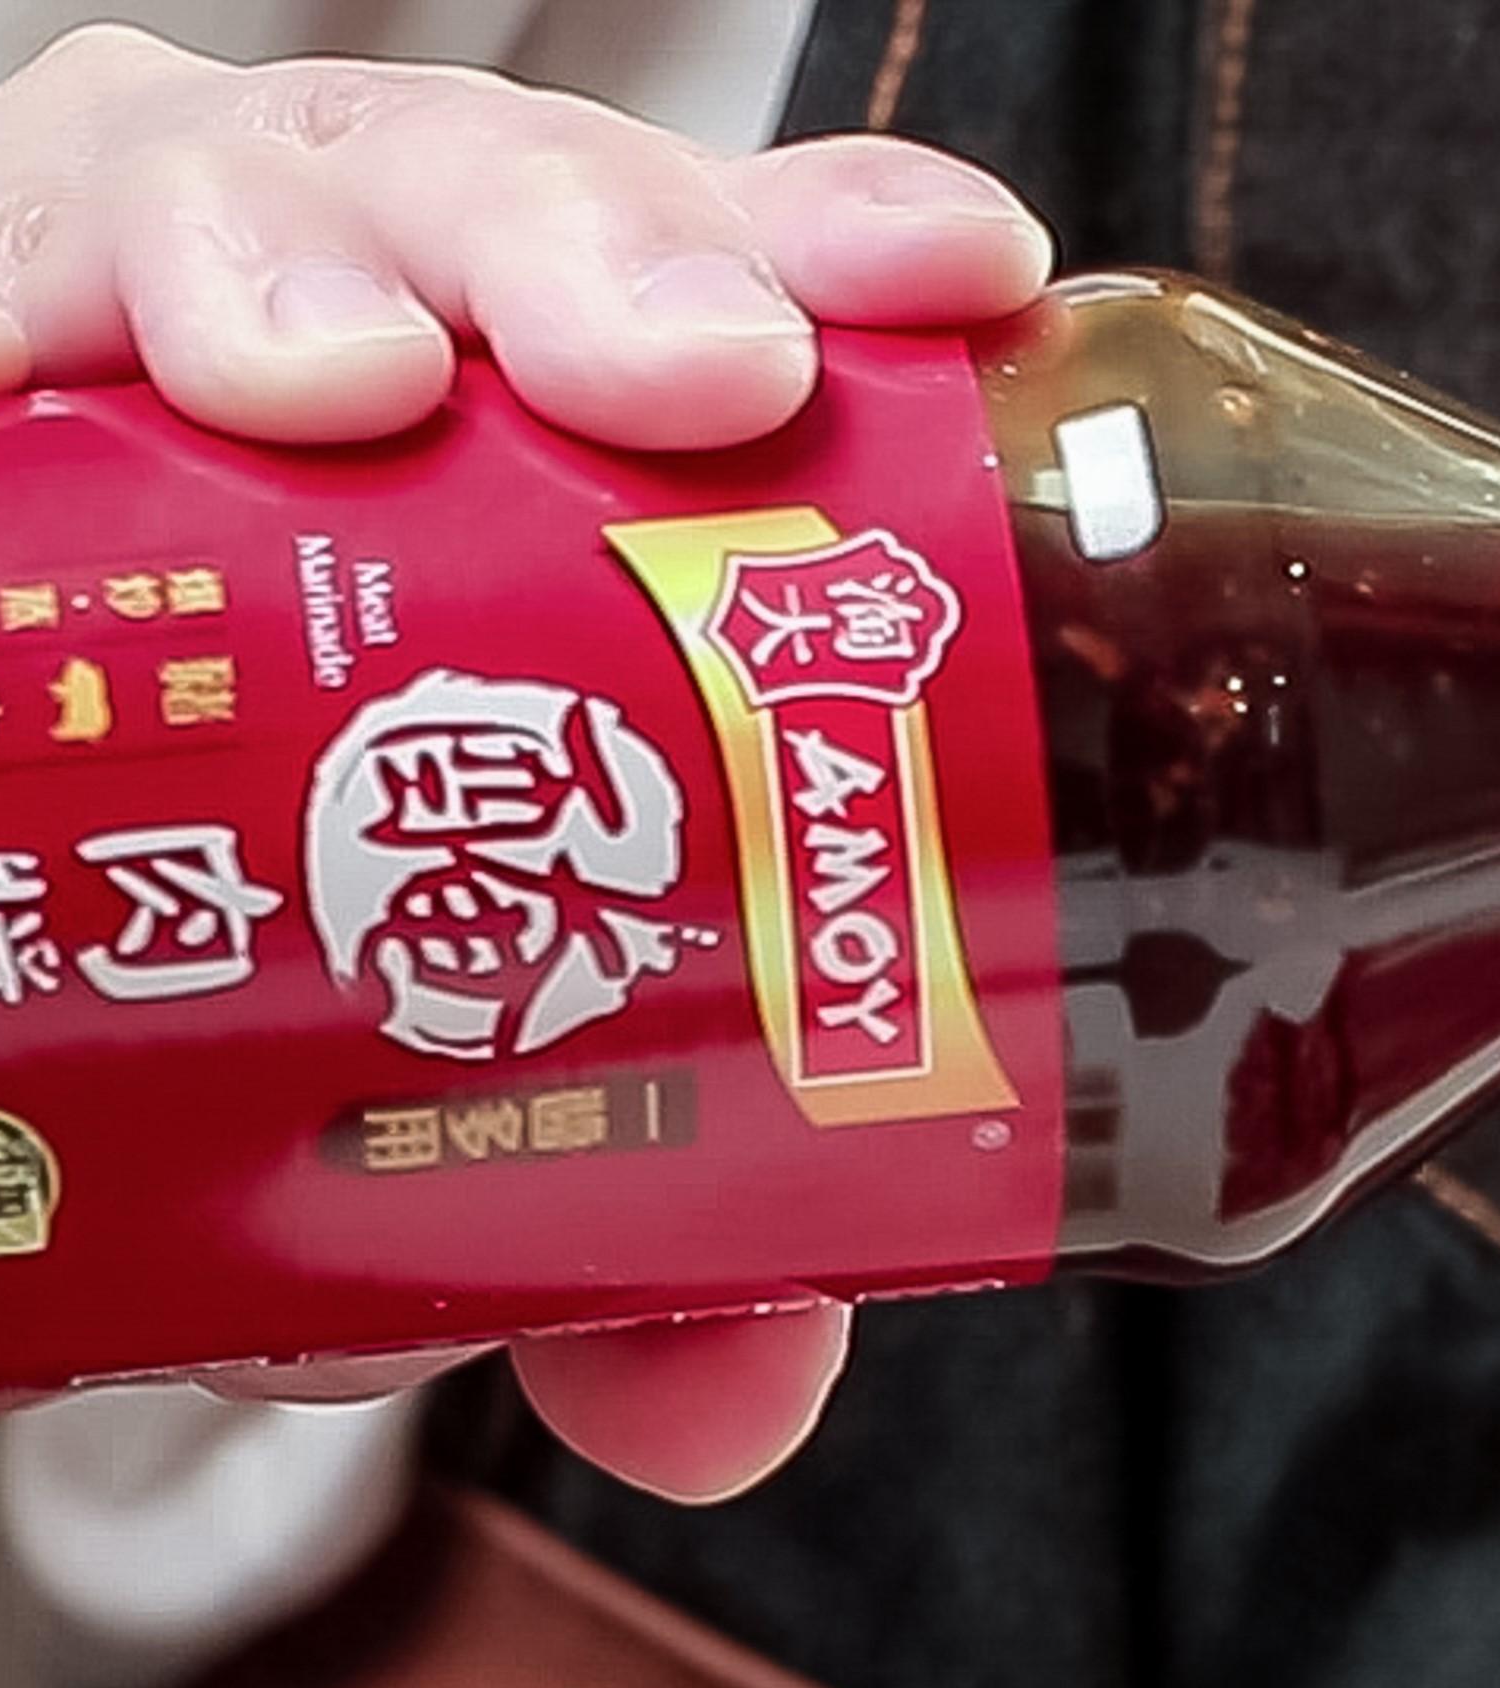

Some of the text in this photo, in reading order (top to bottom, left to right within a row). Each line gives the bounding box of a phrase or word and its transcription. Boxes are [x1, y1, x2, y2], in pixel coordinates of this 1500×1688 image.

[352, 562, 396, 645] Meat
[739, 576, 923, 664] 淘大
[782, 731, 900, 1043] AMOY
